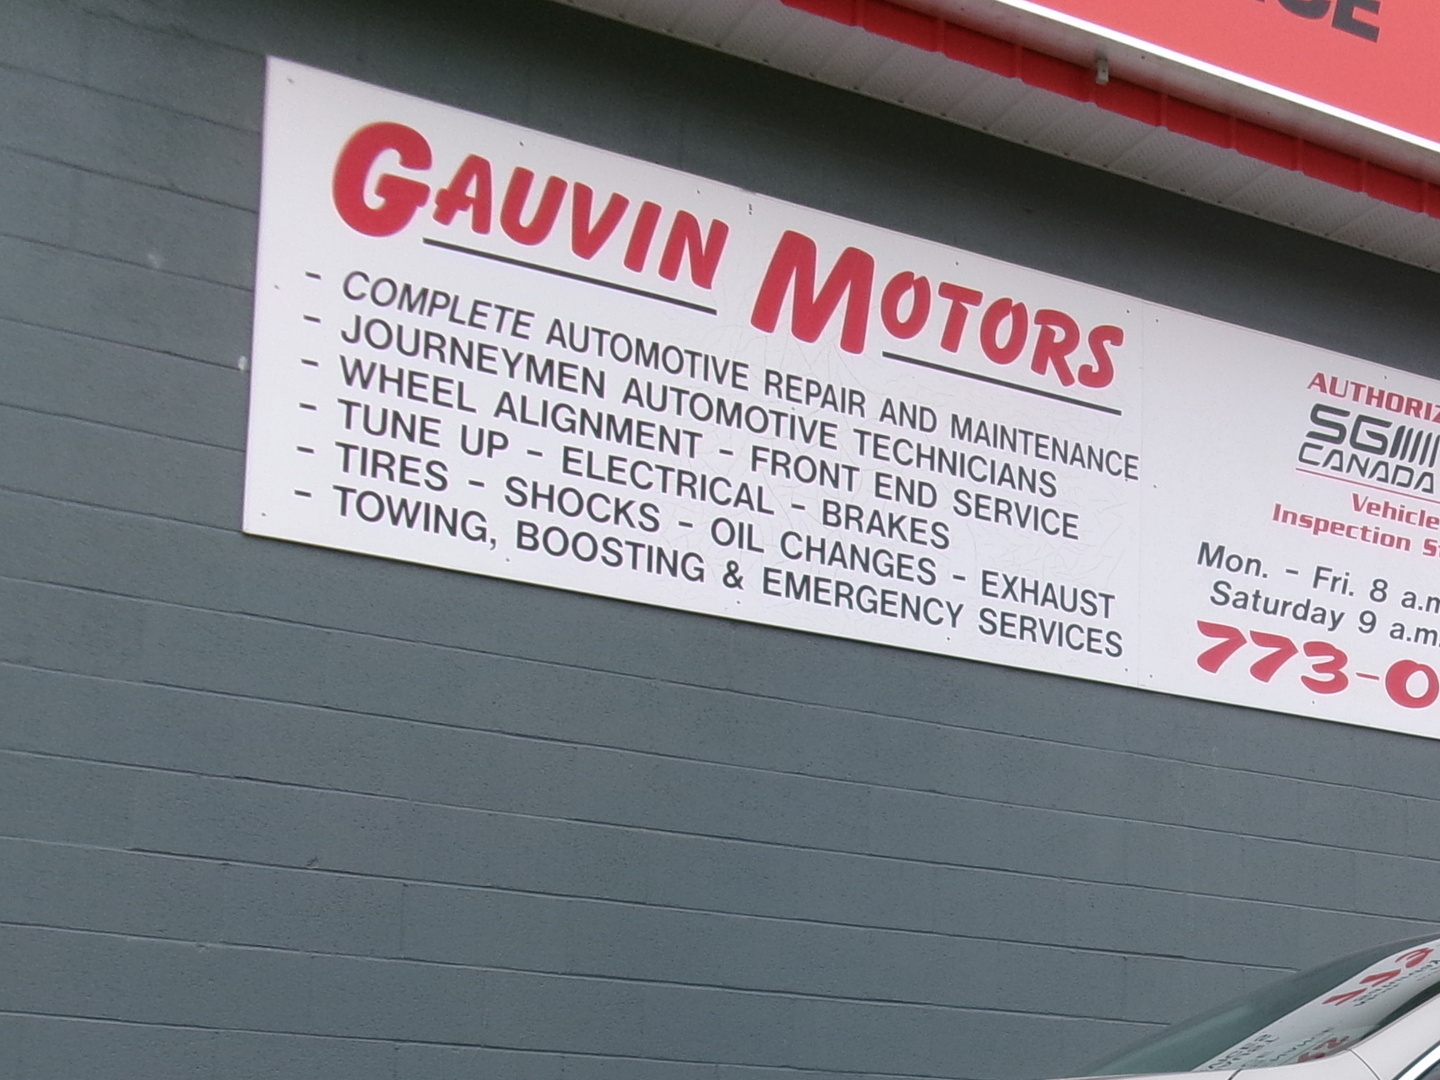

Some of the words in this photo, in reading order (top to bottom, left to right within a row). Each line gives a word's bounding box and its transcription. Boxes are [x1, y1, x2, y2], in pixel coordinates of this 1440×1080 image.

[333, 122, 729, 289] GAUVIN
[751, 231, 1124, 388] MOTORS
[340, 355, 476, 412] WHEEL
[494, 392, 702, 458] ALIGNMENT
[752, 445, 860, 491] FRONT
[875, 472, 937, 508] END
[954, 489, 1078, 539] SERVICE
[342, 315, 604, 398] JOURNEYMEN
[622, 378, 837, 450] AUTOMOTIVE
[853, 429, 1056, 497] TECHNICIANS
[343, 271, 534, 339] COMPLETE
[546, 319, 748, 390] AUTOMOTIVE
[765, 369, 865, 417] REPAIR
[880, 398, 936, 432] AND
[952, 414, 1138, 480] MAINTENANCE
[336, 442, 447, 491] TIRES
[505, 477, 659, 532] SHOCKS
[711, 518, 764, 553] OIL
[781, 531, 936, 585] CHANGES
[982, 570, 1115, 618] EXHAUST
[338, 399, 441, 447] TUNE
[461, 425, 508, 458] UP
[563, 446, 774, 515] ELECTRICAL
[823, 499, 949, 549] BRAKES
[1272, 503, 1411, 551] Inspection
[1299, 442, 1433, 494] CANADA
[1352, 494, 1440, 530] Vehicle
[333, 485, 495, 550] TOWING,
[517, 521, 704, 582] BOOSTING
[723, 561, 743, 589] &
[764, 567, 963, 627] EMERGENCY
[979, 608, 1122, 657] SERVICES
[1198, 542, 1267, 578] Mon.
[1313, 566, 1354, 597] Fri.
[1370, 579, 1387, 602] 8
[1211, 581, 1344, 631] Saturday
[1359, 611, 1376, 633] 9
